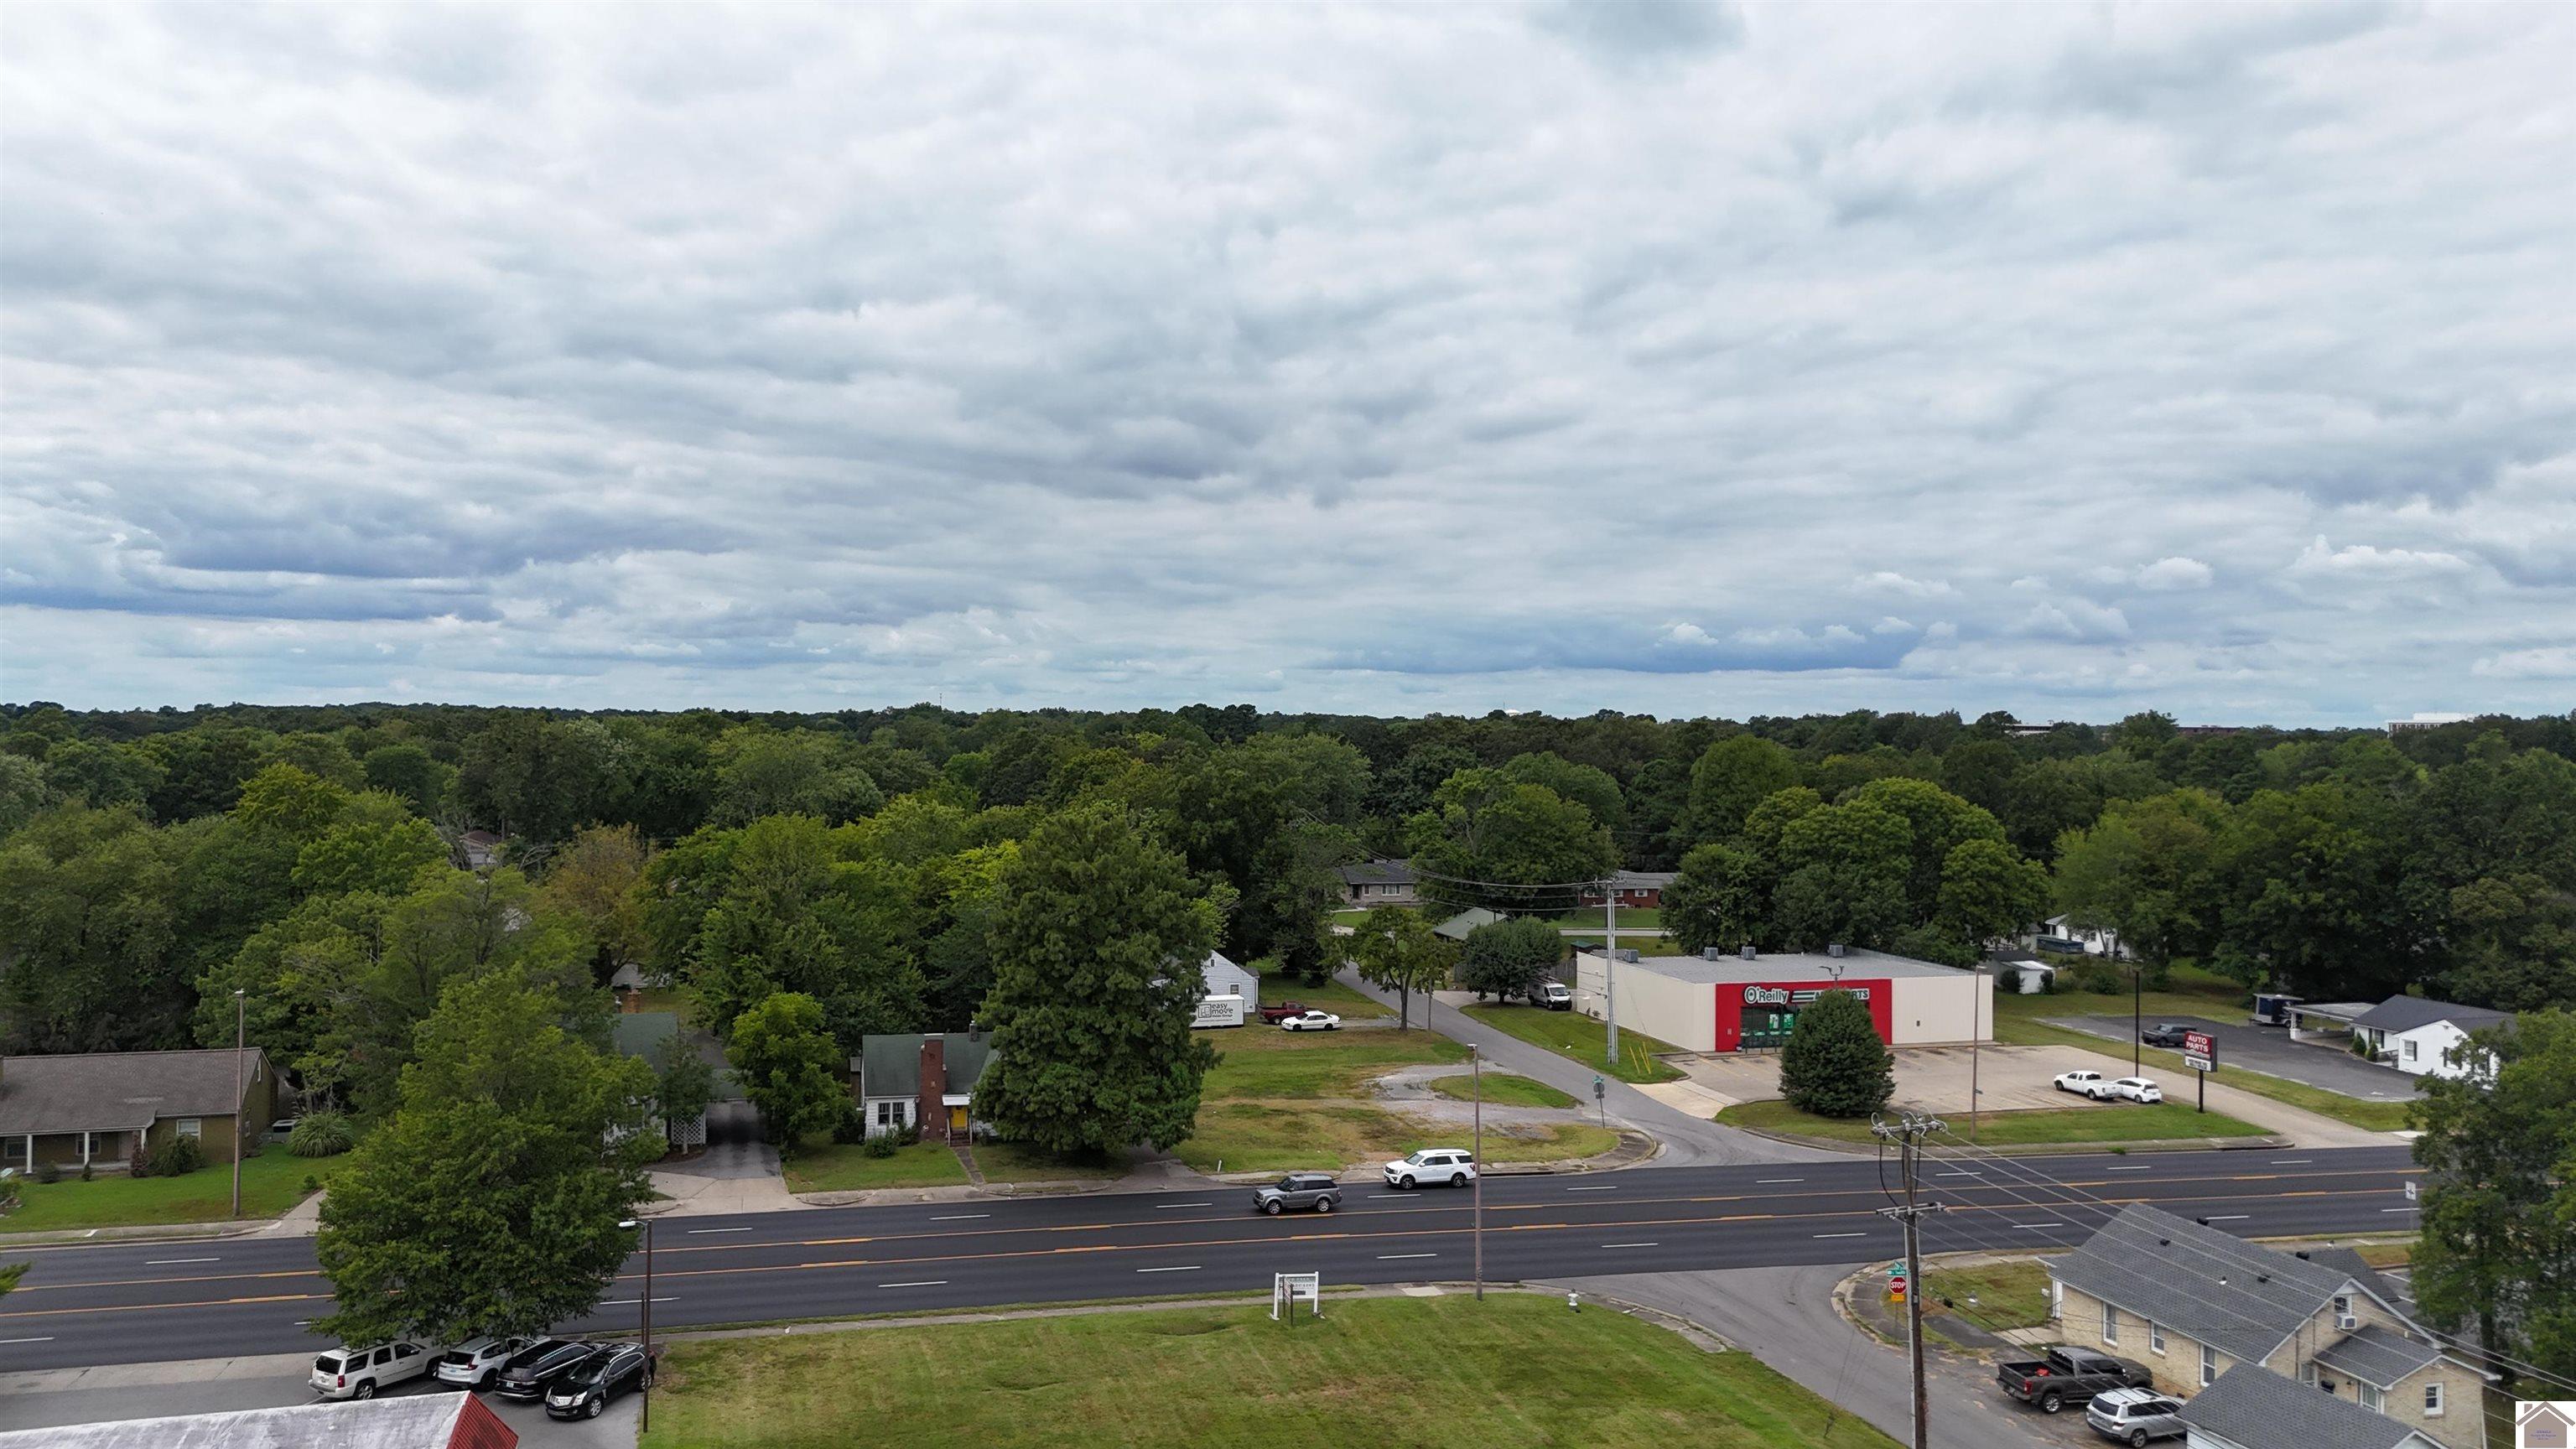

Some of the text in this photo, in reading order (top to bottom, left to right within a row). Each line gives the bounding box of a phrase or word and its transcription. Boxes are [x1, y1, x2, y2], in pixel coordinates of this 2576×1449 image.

[1746, 987, 1788, 1004] O'Reilly
[2188, 1035, 2207, 1045] AUTO
[2186, 1041, 2209, 1052] PARTS
